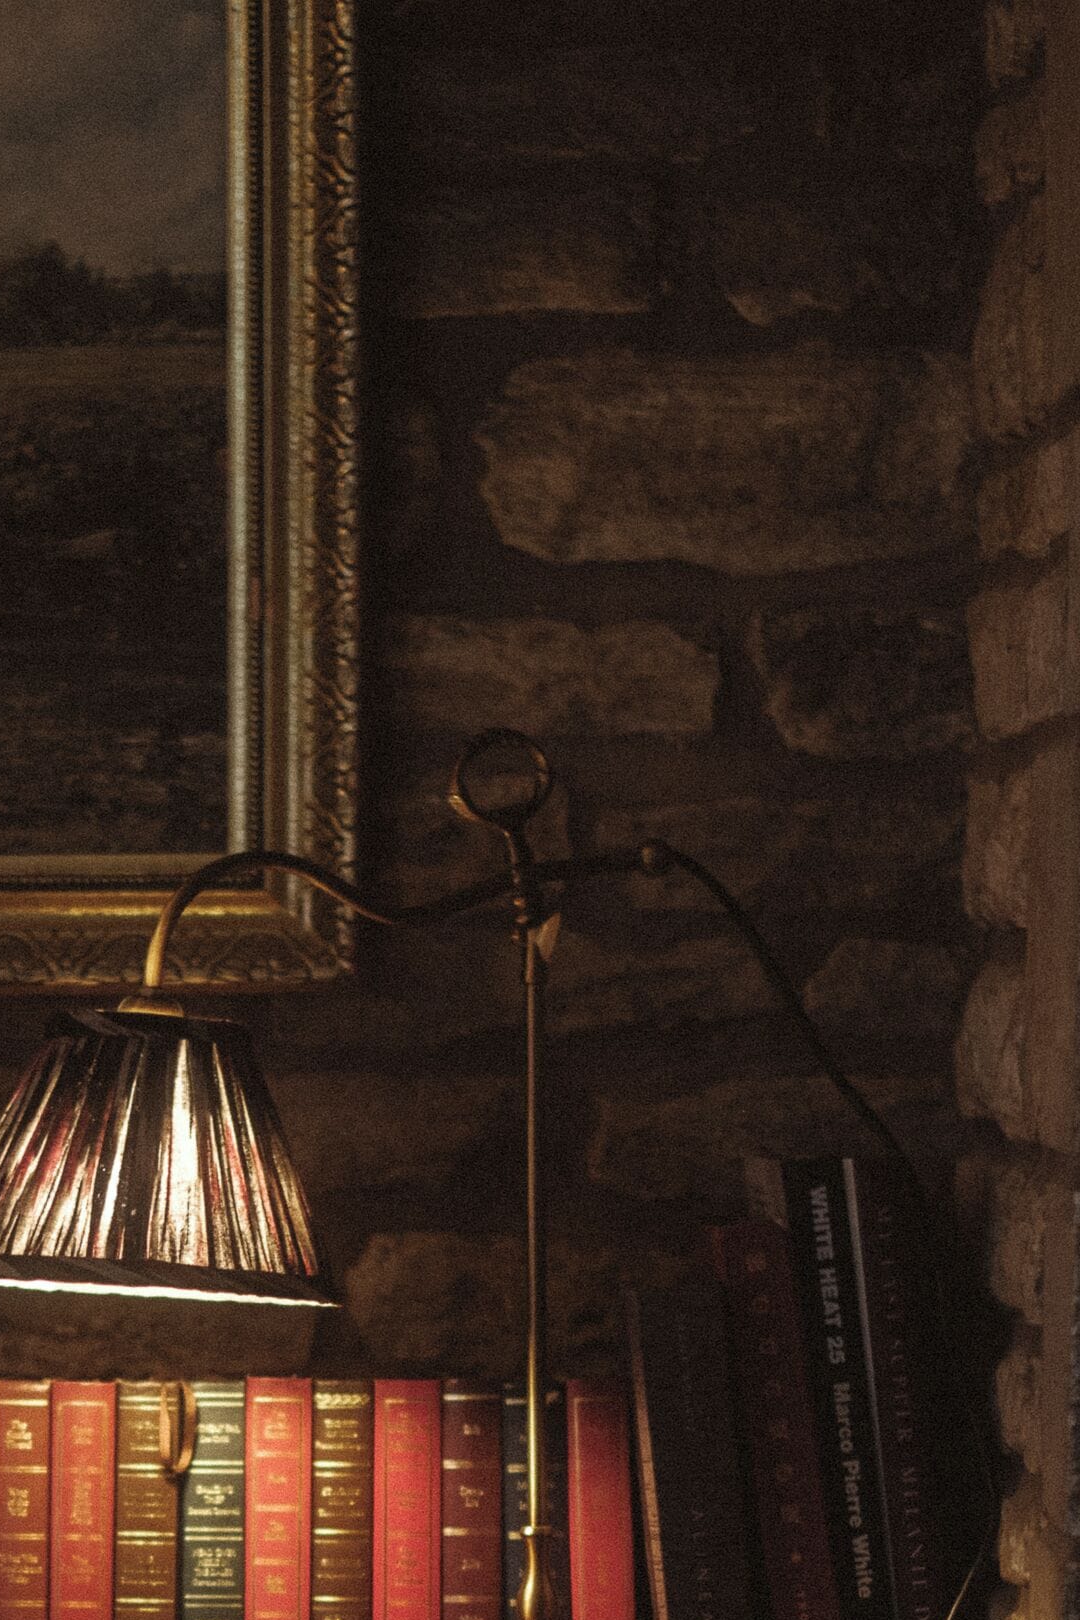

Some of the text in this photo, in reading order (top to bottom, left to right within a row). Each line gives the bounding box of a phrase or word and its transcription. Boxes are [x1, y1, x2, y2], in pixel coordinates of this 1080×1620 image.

[810, 1187, 873, 1600] WHITE HEAT 25 Marco Pierre White
